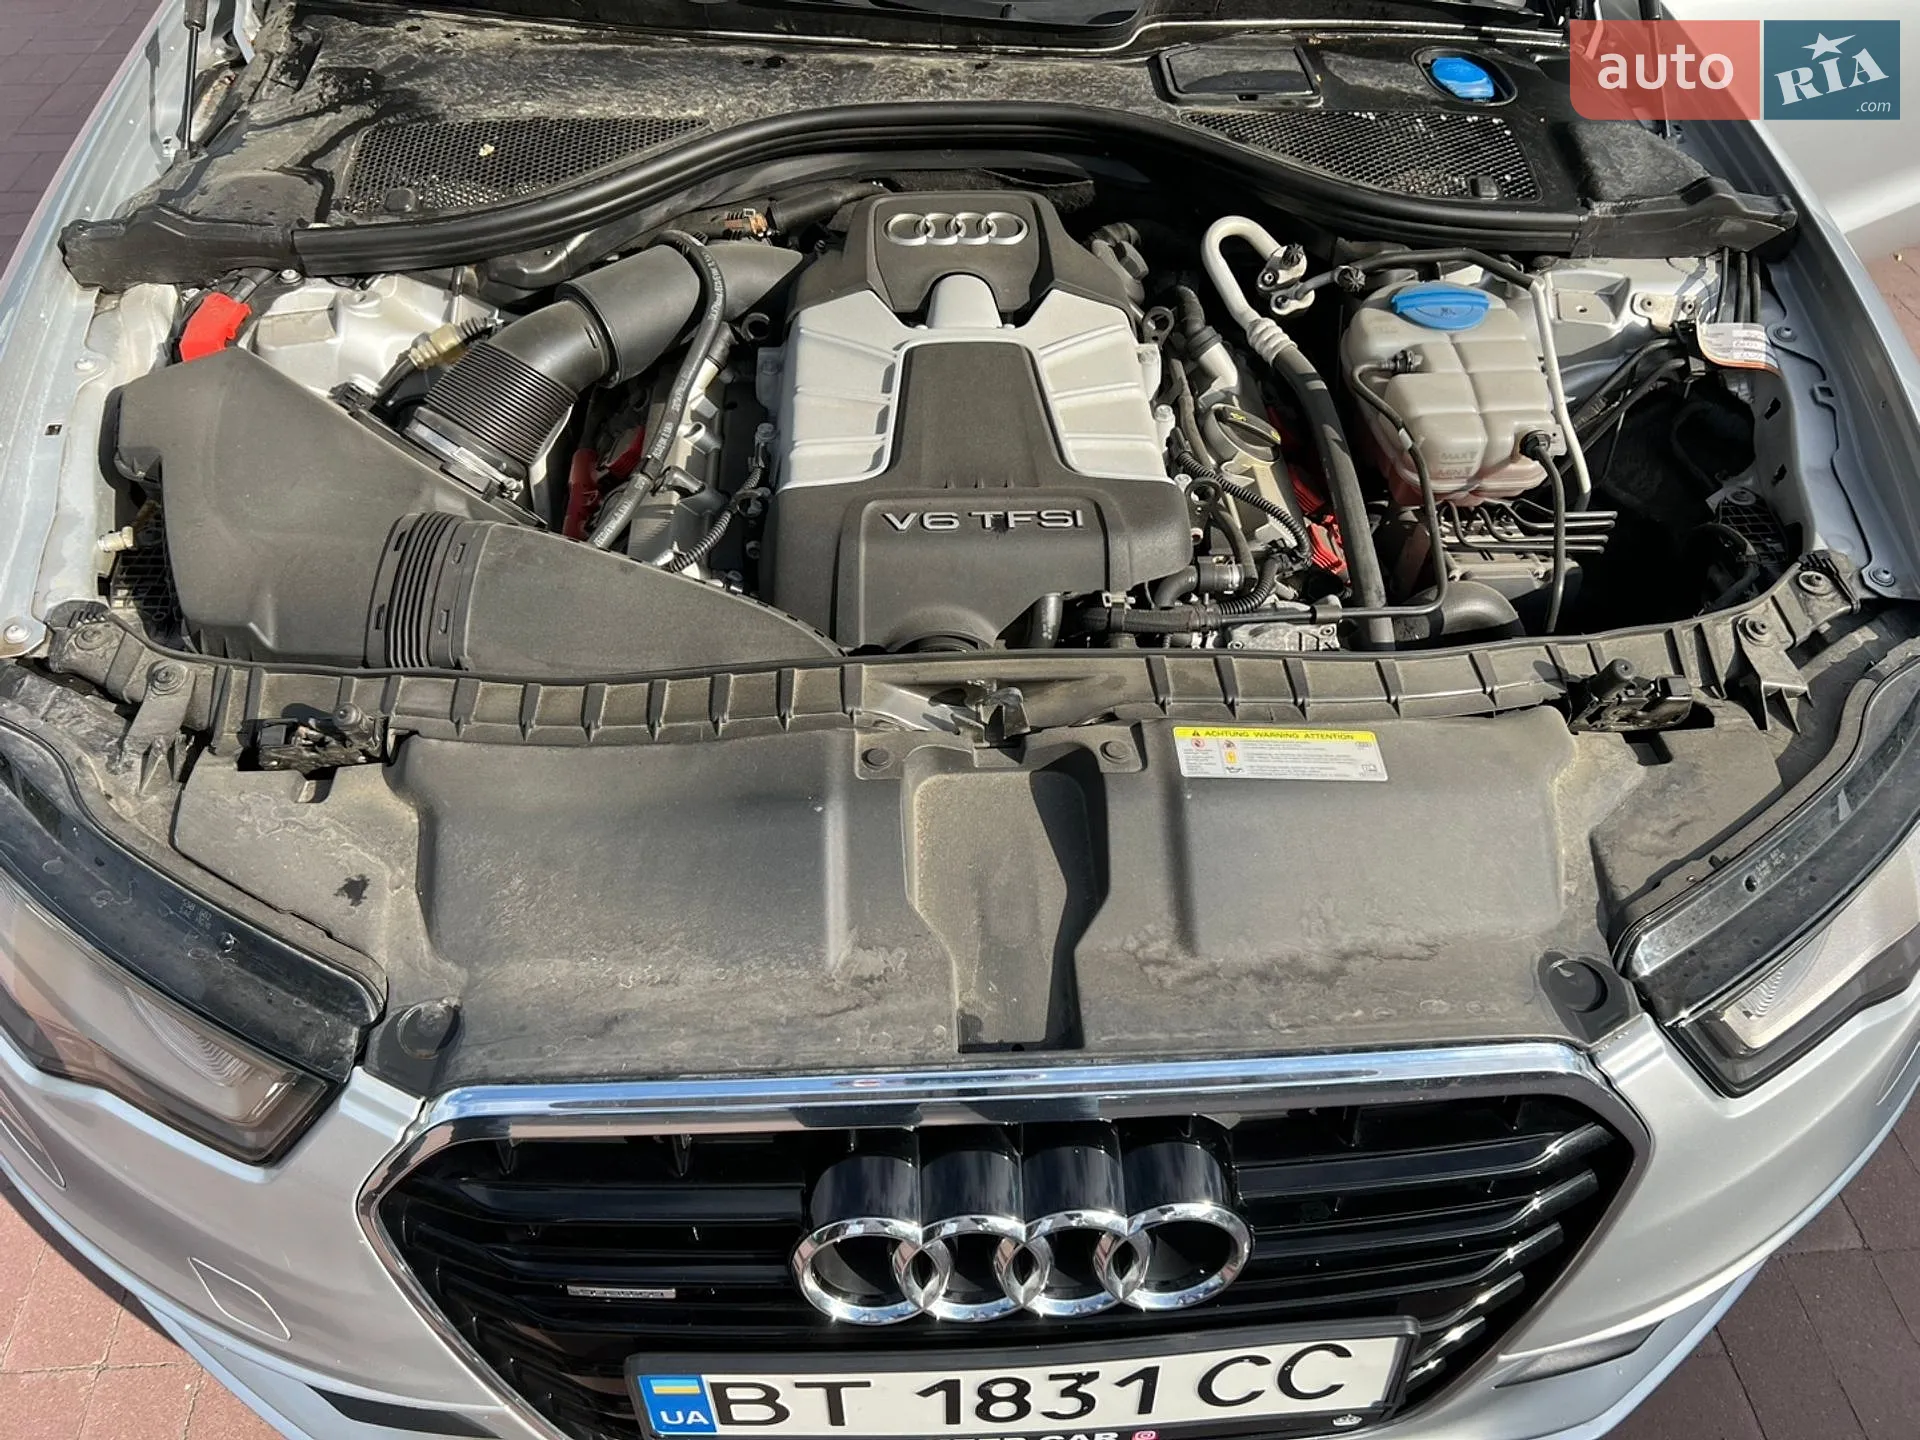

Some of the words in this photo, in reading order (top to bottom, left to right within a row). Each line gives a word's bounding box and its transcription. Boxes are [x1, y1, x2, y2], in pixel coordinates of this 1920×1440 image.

[882, 511, 960, 531] V6
[968, 509, 1085, 530] TFSI
[709, 1381, 871, 1426] BT
[915, 1364, 1161, 1425] 1831
[1196, 1343, 1352, 1406] CC
[660, 1410, 709, 1425] UA
